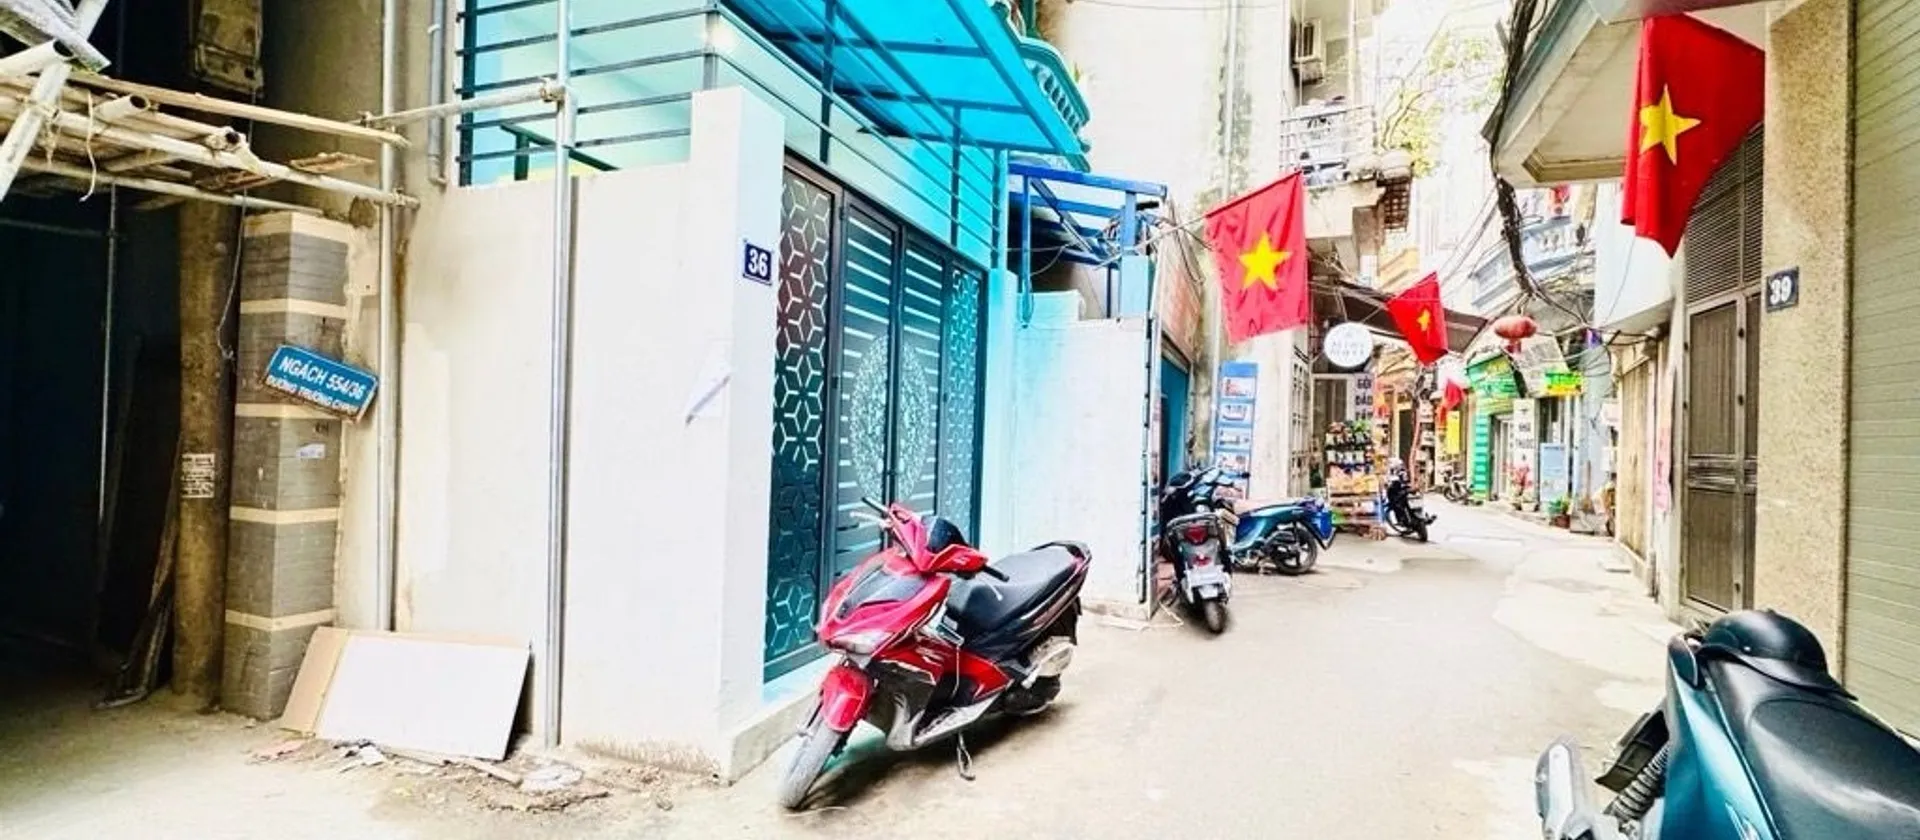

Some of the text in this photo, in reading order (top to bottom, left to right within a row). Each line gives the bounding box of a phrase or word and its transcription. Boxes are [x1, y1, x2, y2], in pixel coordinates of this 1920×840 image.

[748, 248, 768, 277] 36
[1770, 275, 1792, 305] 39
[279, 356, 367, 400] NGÁCH 554/36
